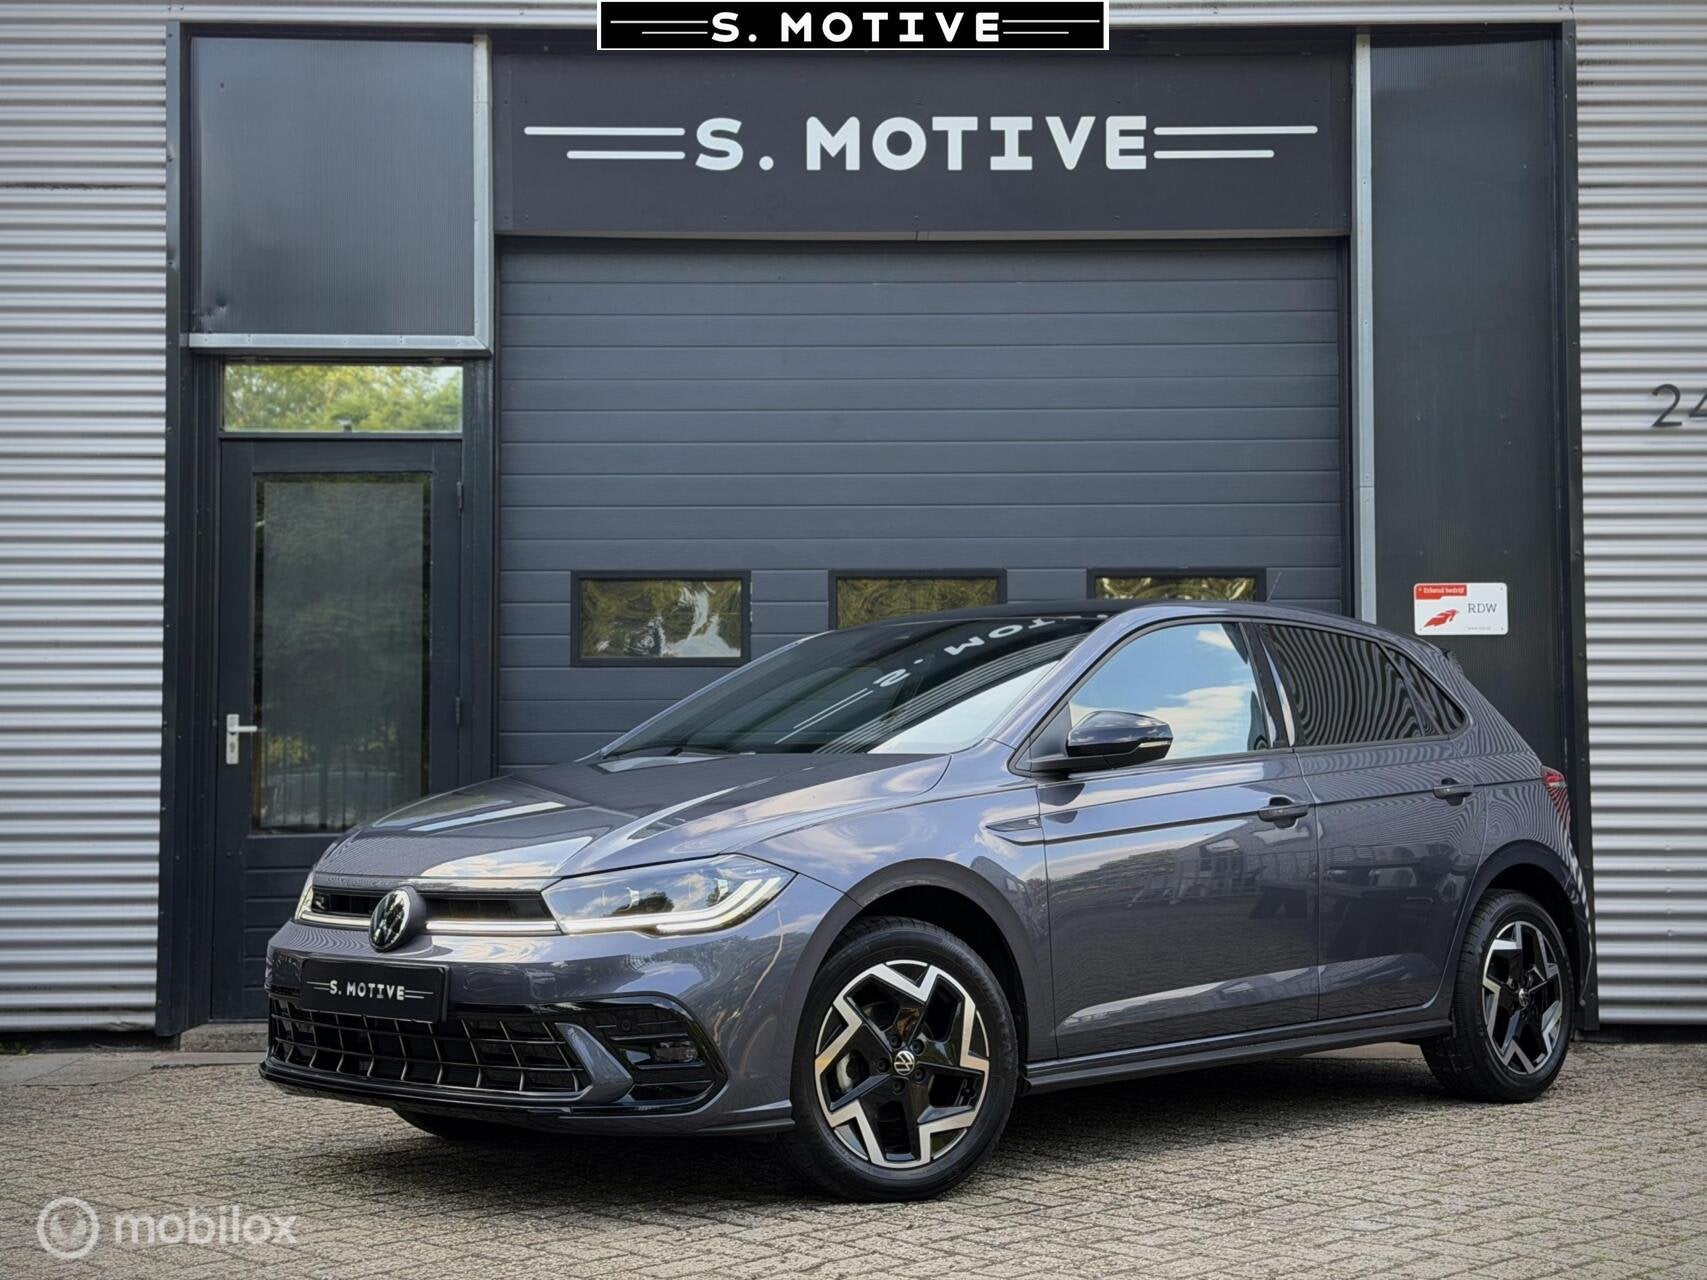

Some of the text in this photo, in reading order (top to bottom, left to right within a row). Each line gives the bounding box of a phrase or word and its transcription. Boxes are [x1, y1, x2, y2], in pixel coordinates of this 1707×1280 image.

[695, 115, 1148, 172] S. MOTIVE
[1467, 602, 1498, 613] RDW
[329, 979, 405, 1001] S. MOTIVE
